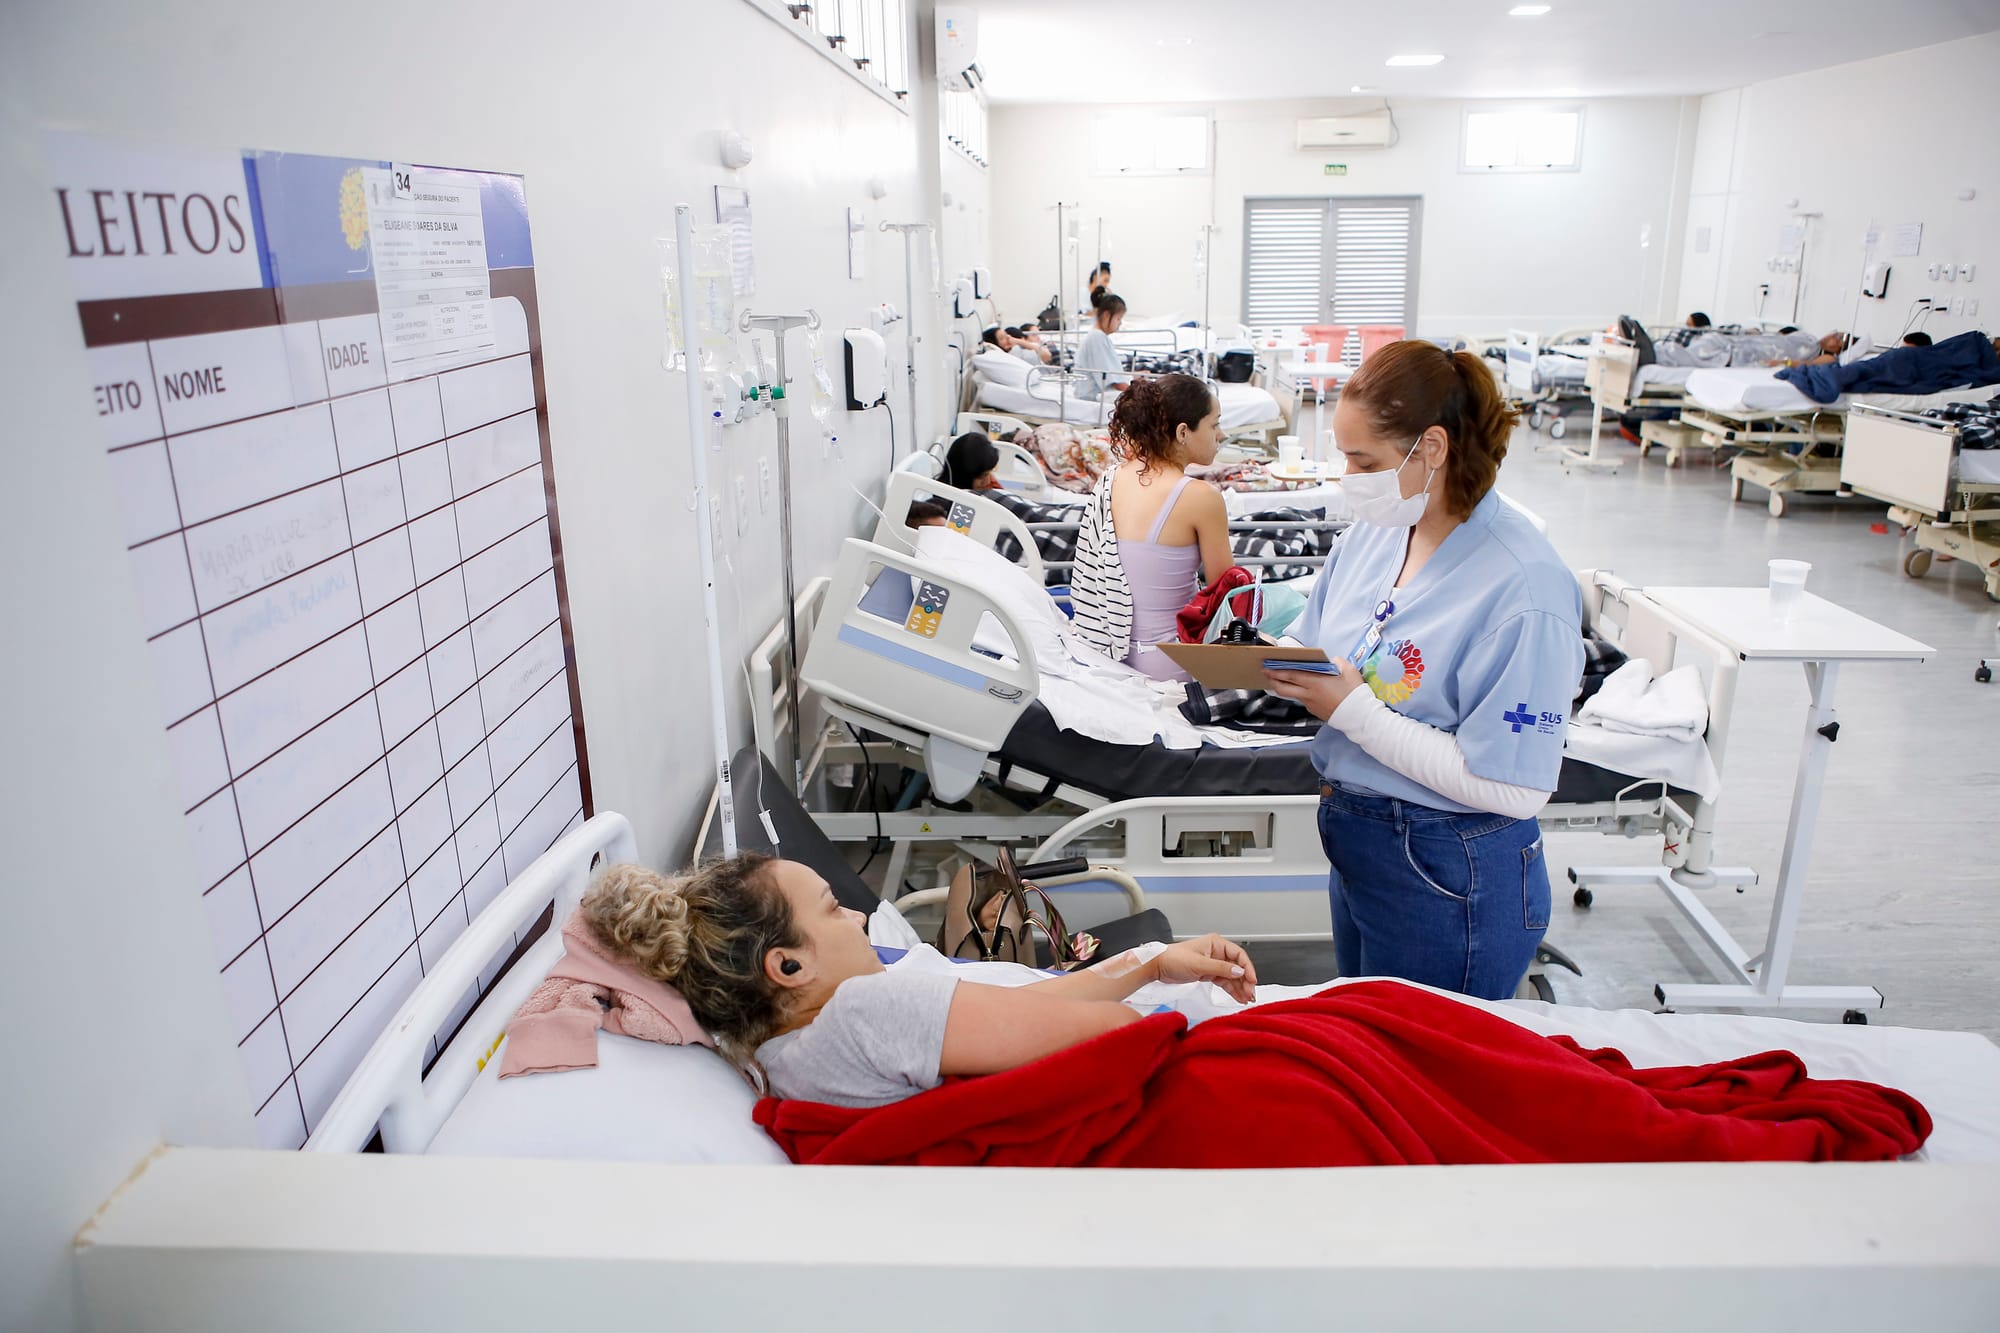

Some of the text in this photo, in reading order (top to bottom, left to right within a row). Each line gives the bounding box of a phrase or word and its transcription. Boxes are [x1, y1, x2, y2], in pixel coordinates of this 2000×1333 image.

[395, 172, 411, 192] 34
[53, 188, 246, 258] LEITOS
[434, 222, 442, 232] DA
[442, 222, 459, 232] SILVA
[327, 342, 369, 370] IDADE
[163, 366, 226, 401] NOME
[1540, 711, 1562, 724] SUS
